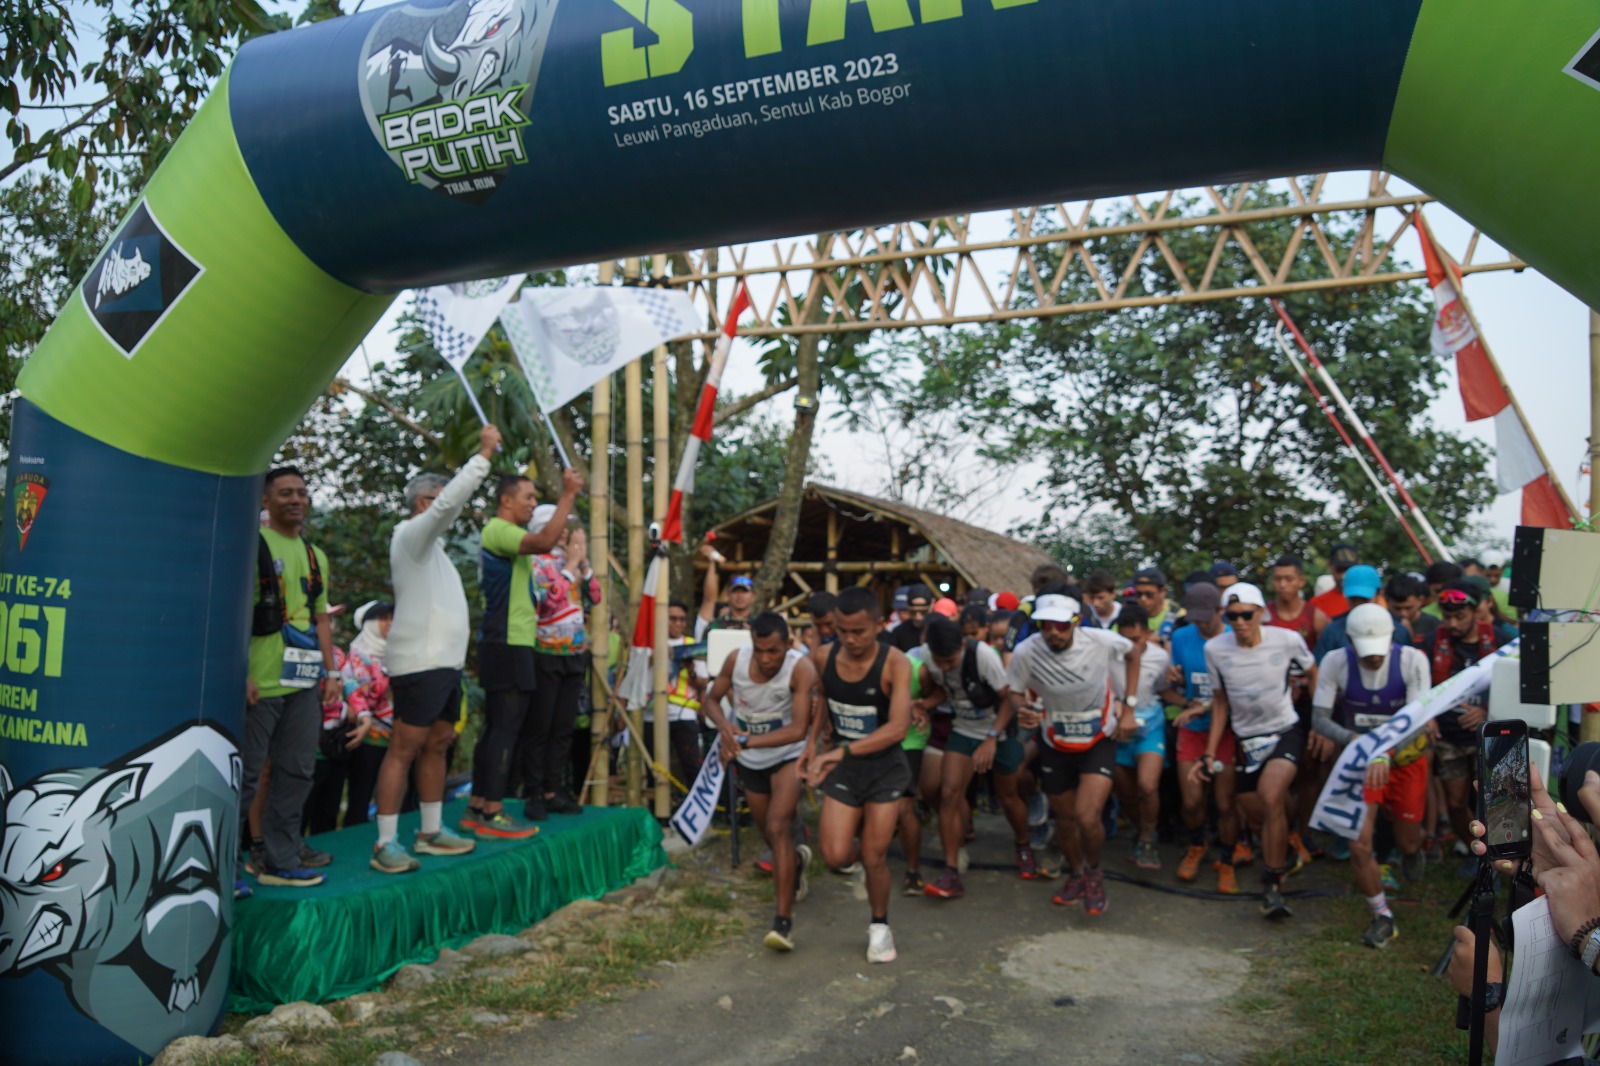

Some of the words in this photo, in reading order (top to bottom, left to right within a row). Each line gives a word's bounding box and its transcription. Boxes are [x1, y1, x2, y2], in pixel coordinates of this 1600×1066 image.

[381, 89, 525, 150] BADAK
[607, 95, 680, 126] SABTU,
[684, 88, 709, 111] 16
[711, 65, 839, 105] SEPTEMBER
[843, 52, 900, 82] 2023
[613, 124, 660, 148] Leuwi
[663, 109, 758, 138] Pangaduan,
[760, 96, 815, 122] Sentul
[818, 90, 853, 112] Kab
[856, 82, 912, 106] Bogor
[401, 128, 524, 181] PUTIH
[444, 179, 475, 196] TRAIL
[475, 176, 497, 190] RUN
[15, 574, 72, 599] KE-74
[680, 741, 722, 834] FINIS
